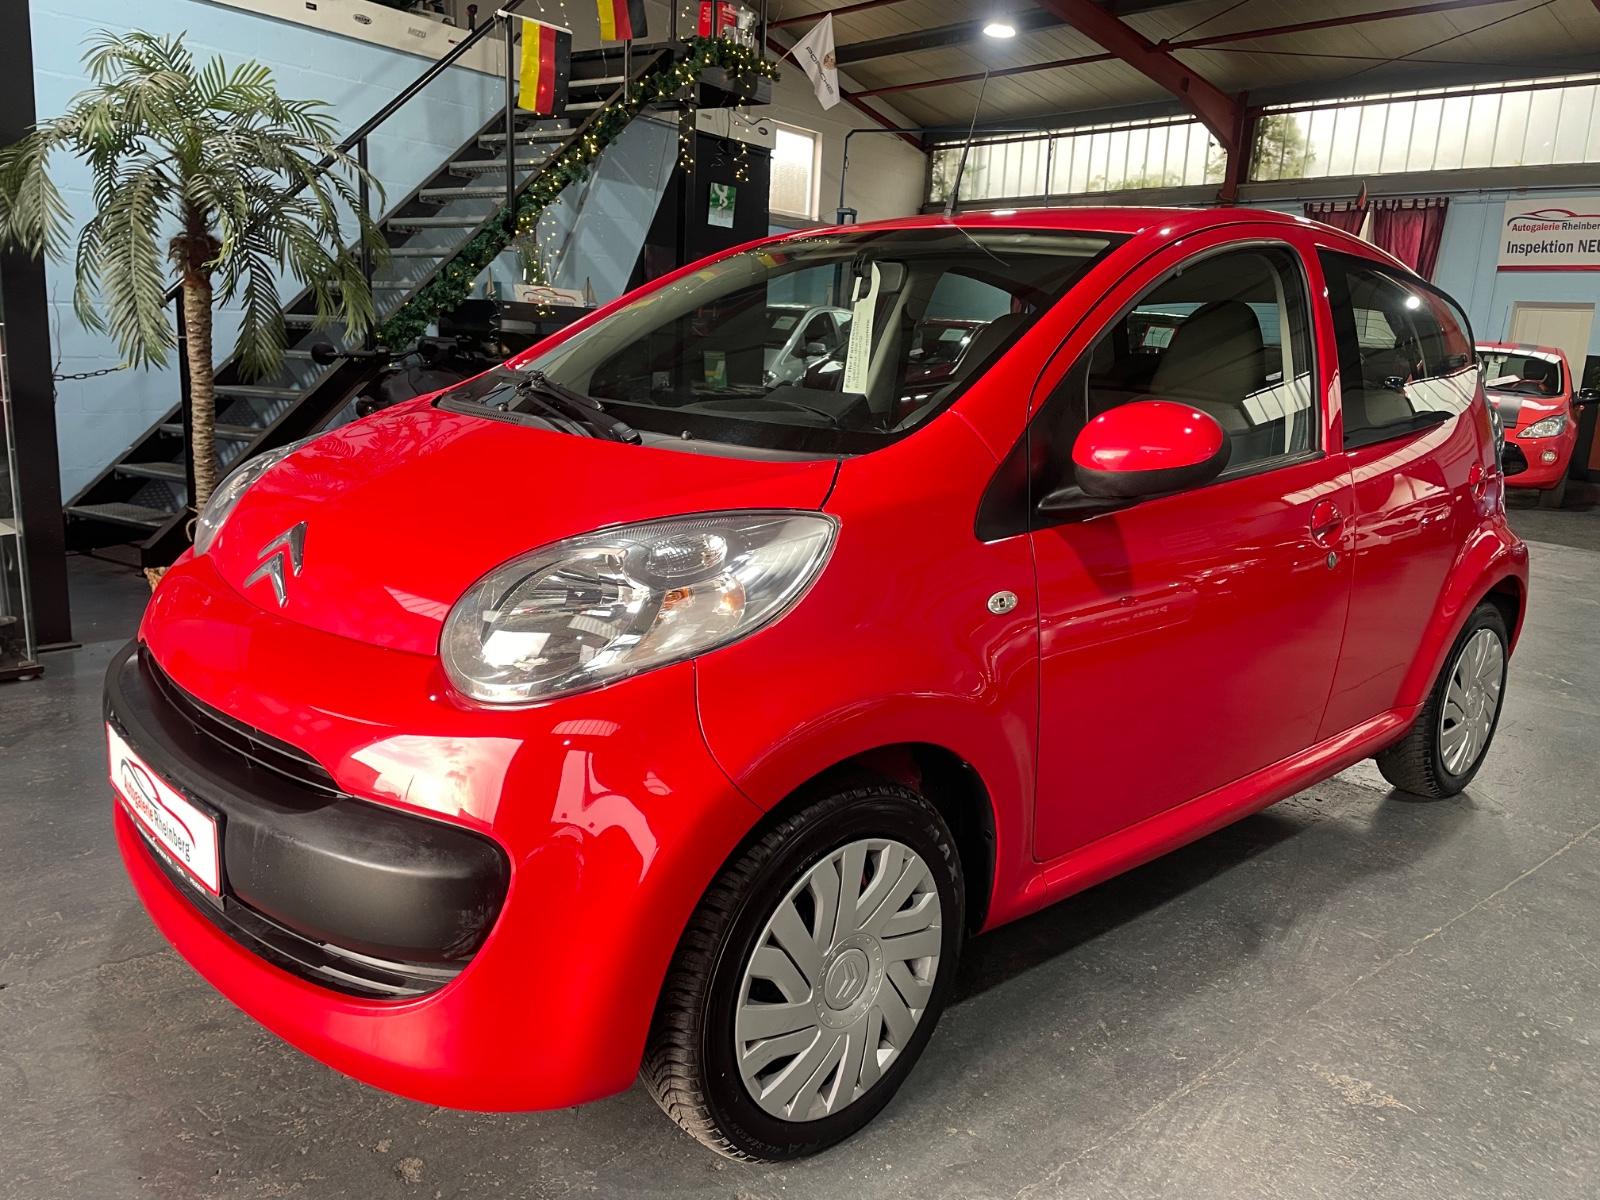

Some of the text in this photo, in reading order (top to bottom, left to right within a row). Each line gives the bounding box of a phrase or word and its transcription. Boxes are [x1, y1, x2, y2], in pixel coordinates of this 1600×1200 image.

[806, 46, 834, 94] PORCHE
[1512, 223, 1560, 233] Autogalerie
[1507, 240, 1573, 256] Inspektion
[154, 809, 191, 863] Rheinberg
